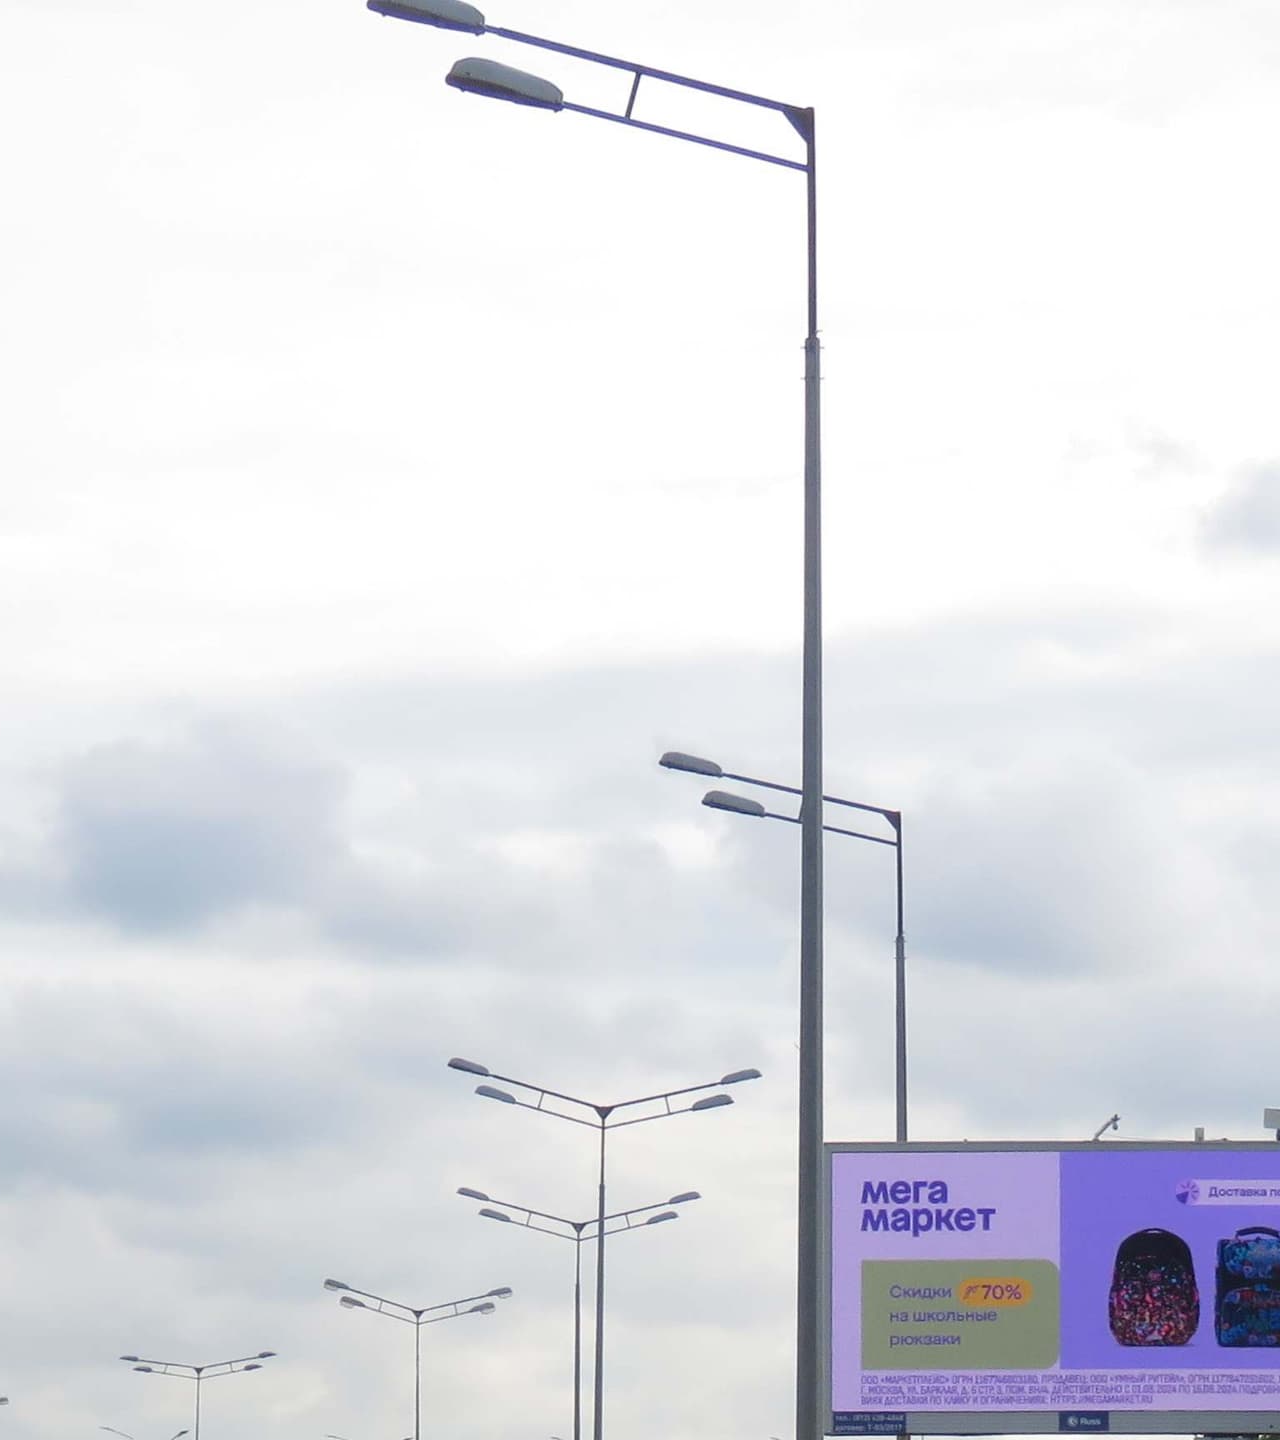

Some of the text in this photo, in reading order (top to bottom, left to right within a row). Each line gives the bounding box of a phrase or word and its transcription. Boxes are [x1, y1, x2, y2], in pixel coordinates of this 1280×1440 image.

[861, 1181, 948, 1204] мега
[1208, 1186, 1267, 1198] Доставка
[861, 1208, 996, 1237] маркет
[889, 1284, 952, 1300] Скидки
[981, 1284, 1023, 1300] 70%
[889, 1311, 997, 1322] на школьные
[889, 1335, 961, 1348] рюкзаки
